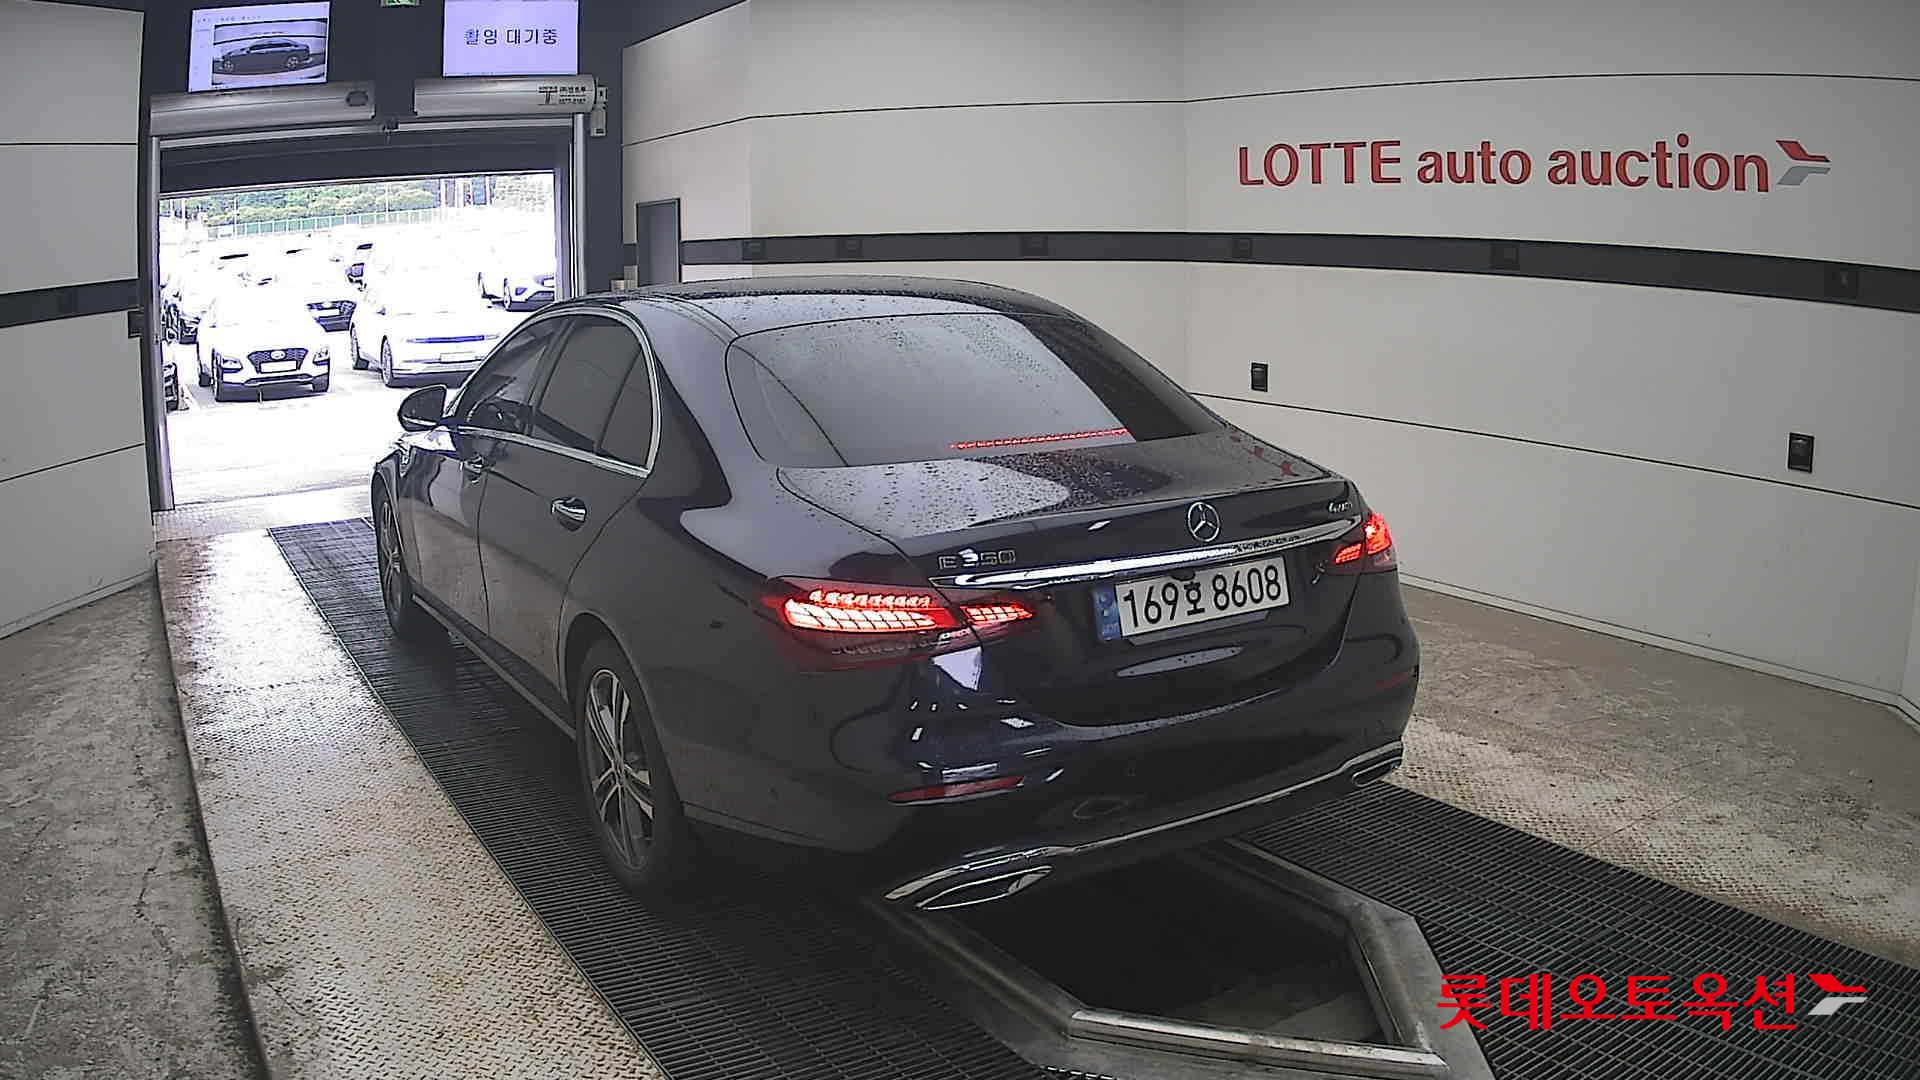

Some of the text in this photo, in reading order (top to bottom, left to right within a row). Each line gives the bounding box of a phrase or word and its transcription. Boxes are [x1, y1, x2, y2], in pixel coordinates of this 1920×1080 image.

[506, 28, 557, 45] 대기중
[1239, 133, 1769, 193] LOTTE auto auction
[1123, 565, 1281, 628] 169호 8608
